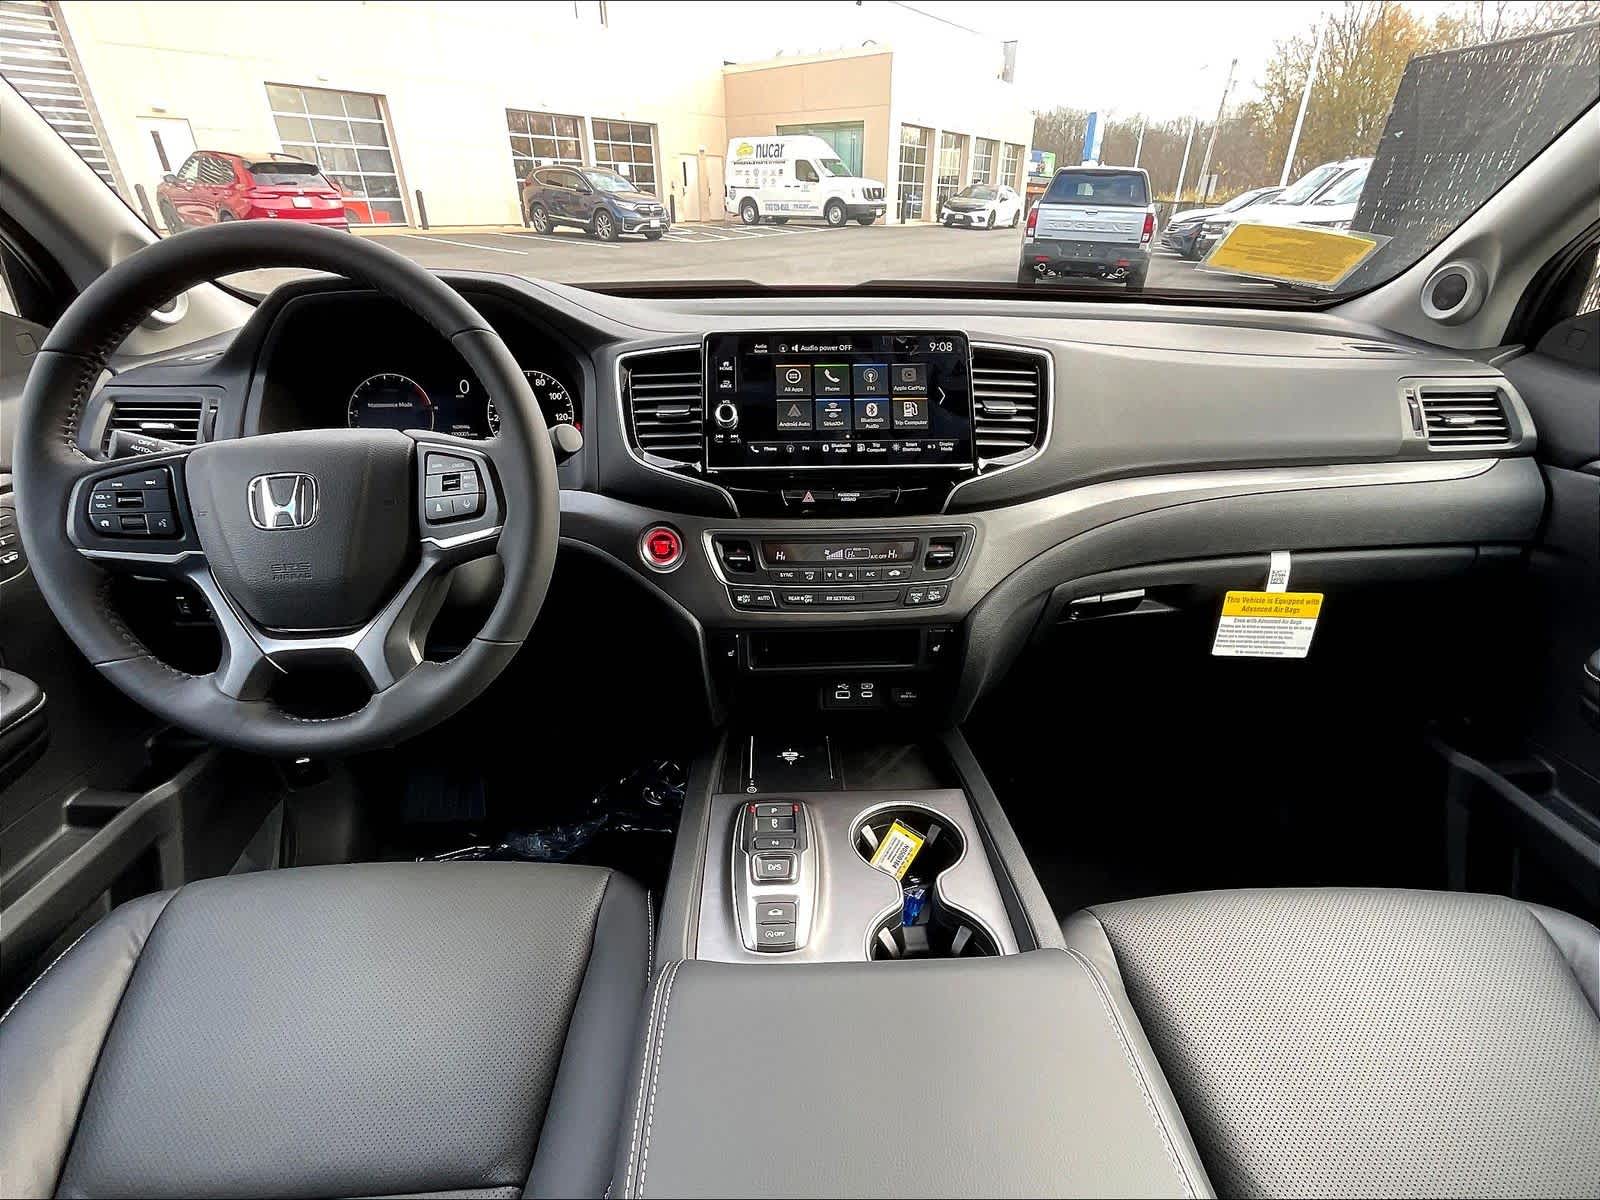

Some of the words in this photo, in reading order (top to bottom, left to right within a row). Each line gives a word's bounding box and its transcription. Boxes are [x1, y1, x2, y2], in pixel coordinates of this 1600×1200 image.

[756, 143, 784, 158] nucar
[1048, 220, 1134, 231] RIDGELINE
[929, 342, 953, 352] 9:08
[460, 379, 470, 394] 0
[549, 392, 562, 400] 100
[555, 413, 568, 421] 120
[1227, 596, 1240, 604] This
[1274, 598, 1304, 607] Equipped
